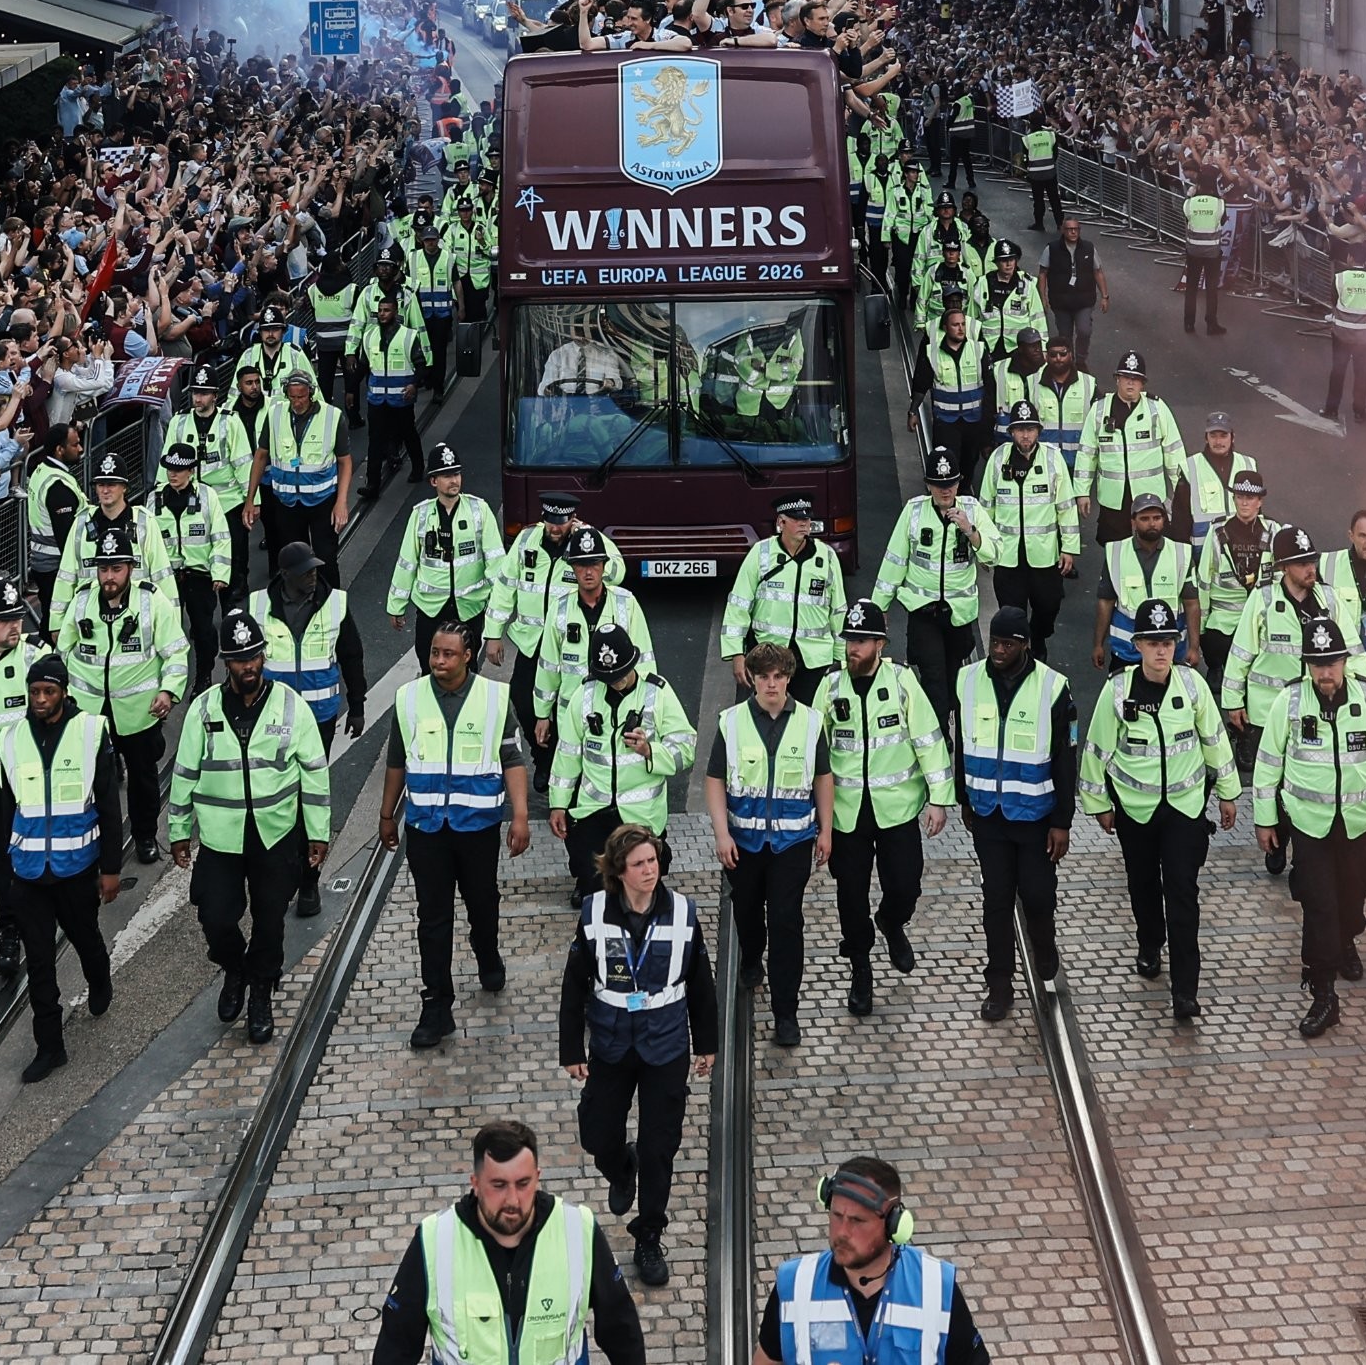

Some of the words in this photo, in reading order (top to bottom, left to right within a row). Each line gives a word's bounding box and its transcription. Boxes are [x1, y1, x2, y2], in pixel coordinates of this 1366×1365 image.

[630, 162, 674, 181] ASTON
[675, 160, 713, 181] VILLA
[542, 269, 587, 285] UEFA
[599, 268, 667, 284] EUROPA
[679, 266, 747, 282] LEAGUE
[758, 264, 804, 280] 2026
[654, 562, 680, 575] OKZ
[683, 561, 710, 574] 266
[267, 725, 290, 735] POLICE
[1176, 731, 1192, 739] POLICE
[527, 1312, 566, 1322] CROWDSAFE
